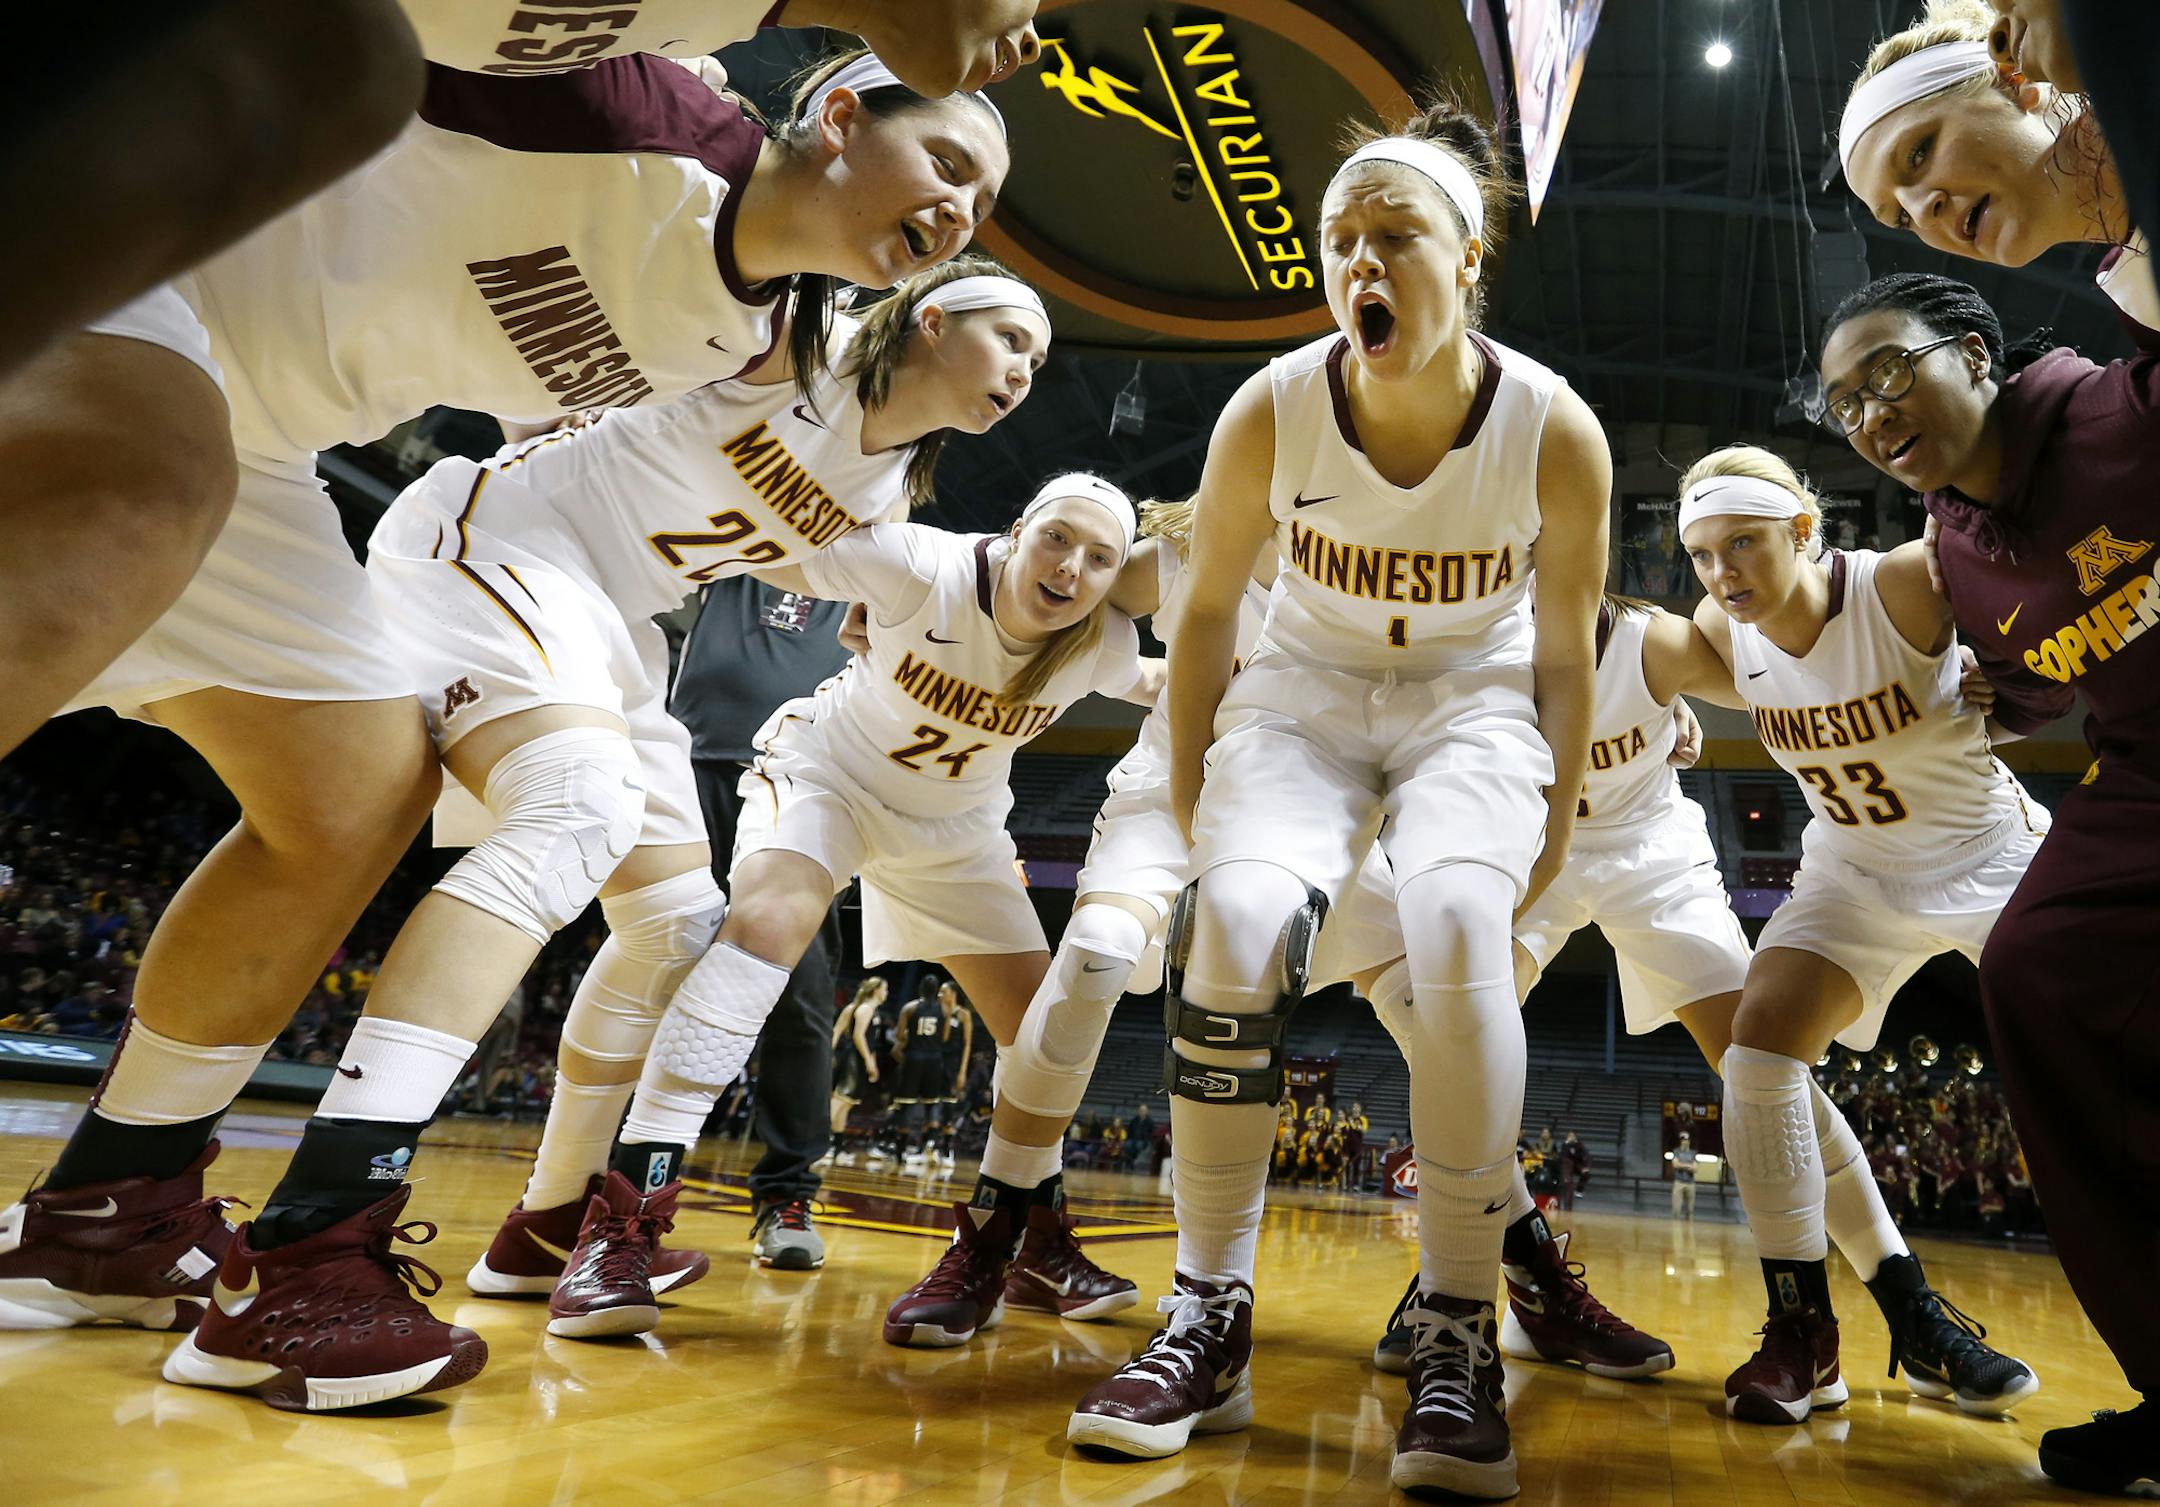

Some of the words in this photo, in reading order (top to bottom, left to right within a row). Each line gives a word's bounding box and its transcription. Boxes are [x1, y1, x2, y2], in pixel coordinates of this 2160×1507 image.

[1171, 23, 1315, 290] SECURIAN
[645, 508, 789, 583] 22
[1291, 520, 1515, 605] MINNESOTA
[2066, 525, 2153, 597] M
[893, 650, 1059, 737] MINNESOTA
[889, 724, 992, 779] 24
[1797, 760, 1910, 827] 33
[916, 1016, 938, 1036] 15
[1179, 1075, 1229, 1091] DONJOY
